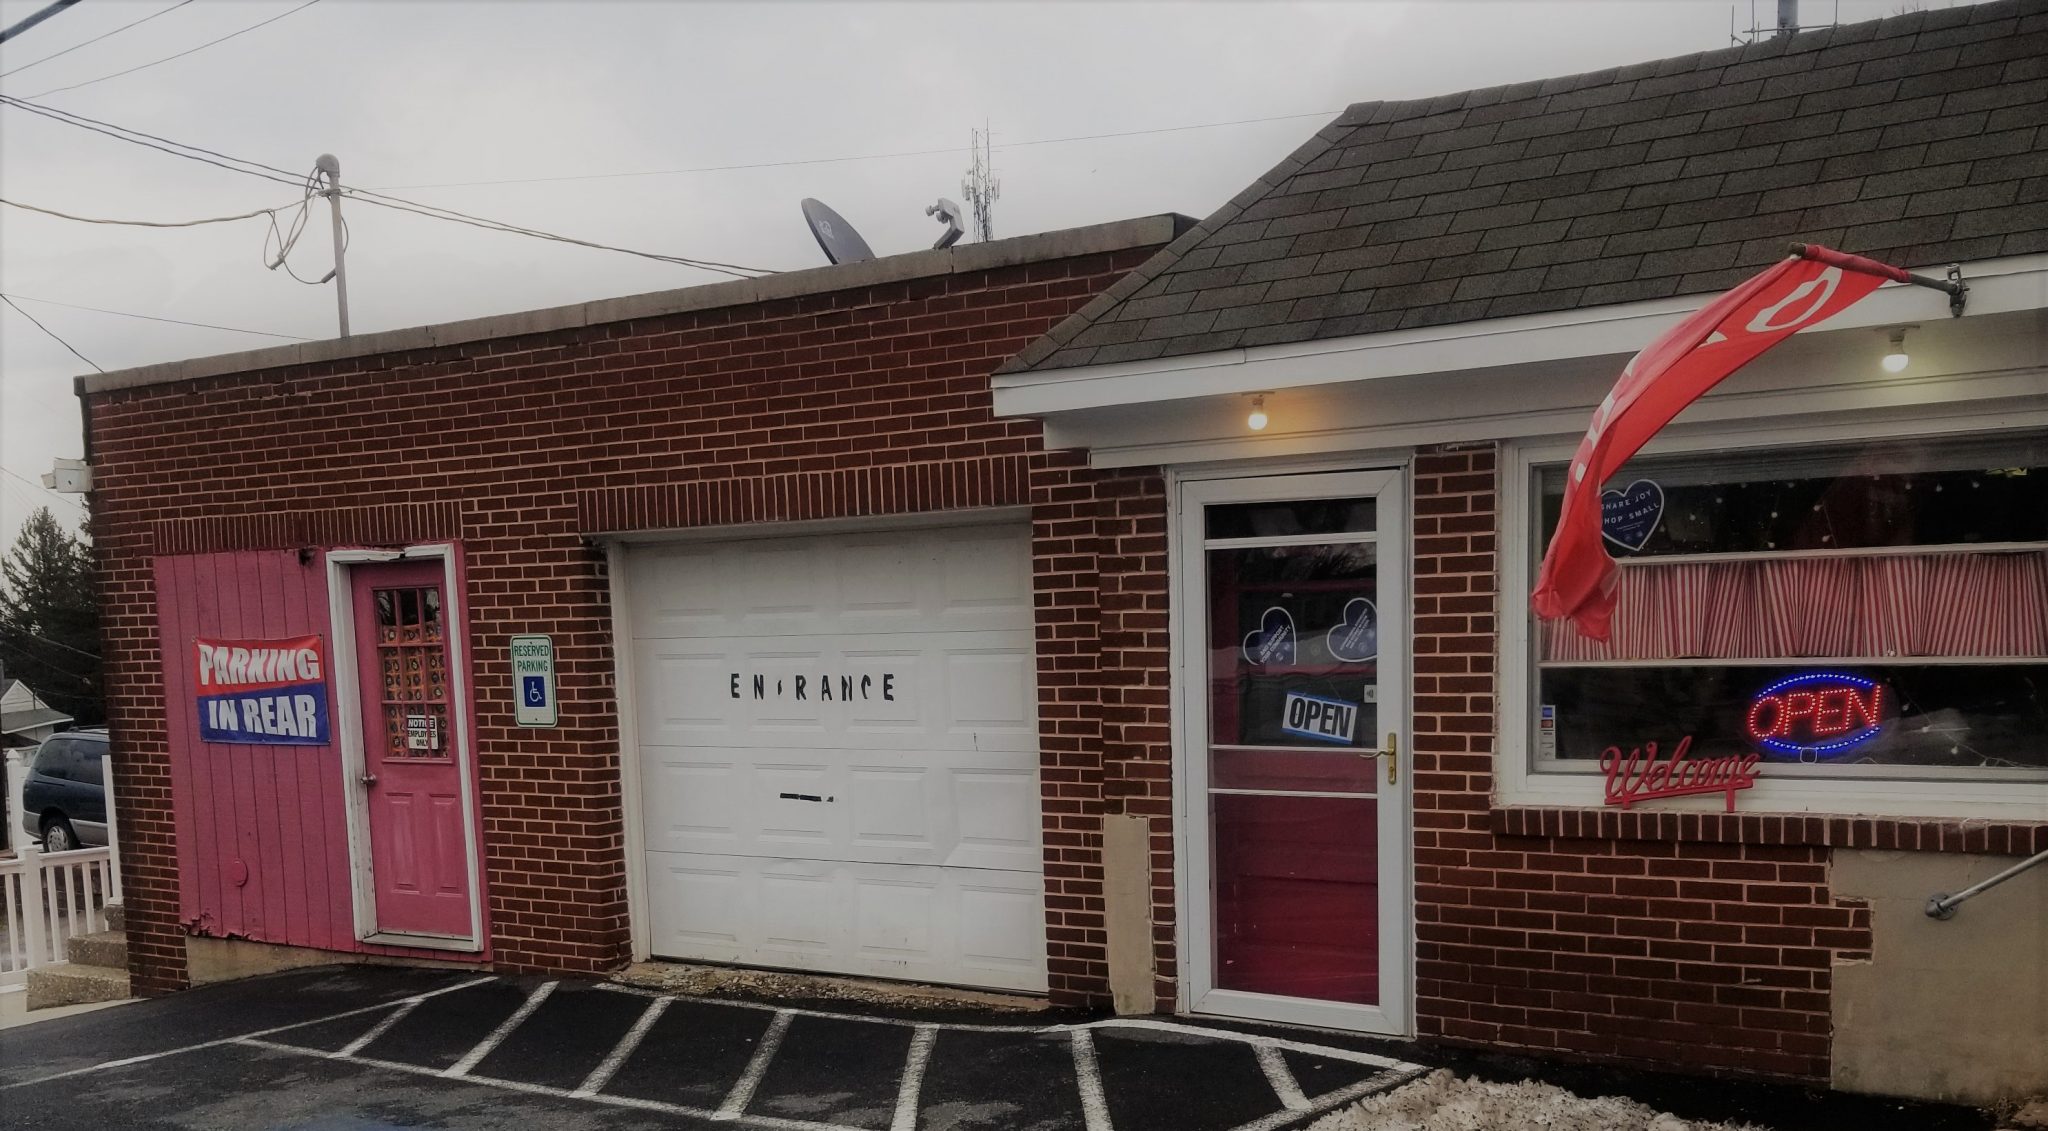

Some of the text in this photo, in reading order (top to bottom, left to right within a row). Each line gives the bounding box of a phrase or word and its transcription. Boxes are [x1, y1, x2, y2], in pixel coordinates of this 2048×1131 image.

[1635, 490, 1651, 502] JOY
[1604, 502, 1660, 525] HOP SMALL
[1267, 625, 1285, 645] SUPPORT
[1268, 625, 1291, 652] COMMUNITY
[514, 645, 549, 657] RESERVED
[199, 644, 320, 686] PARKING
[517, 660, 548, 672] PARKING
[731, 673, 894, 702] ENRANCE
[208, 694, 317, 737] IN REAR
[1288, 697, 1352, 738] OPEN
[1748, 685, 1881, 738] OPEN
[408, 730, 436, 738] EMPLOYES
[1600, 735, 1760, 800] Welcome
